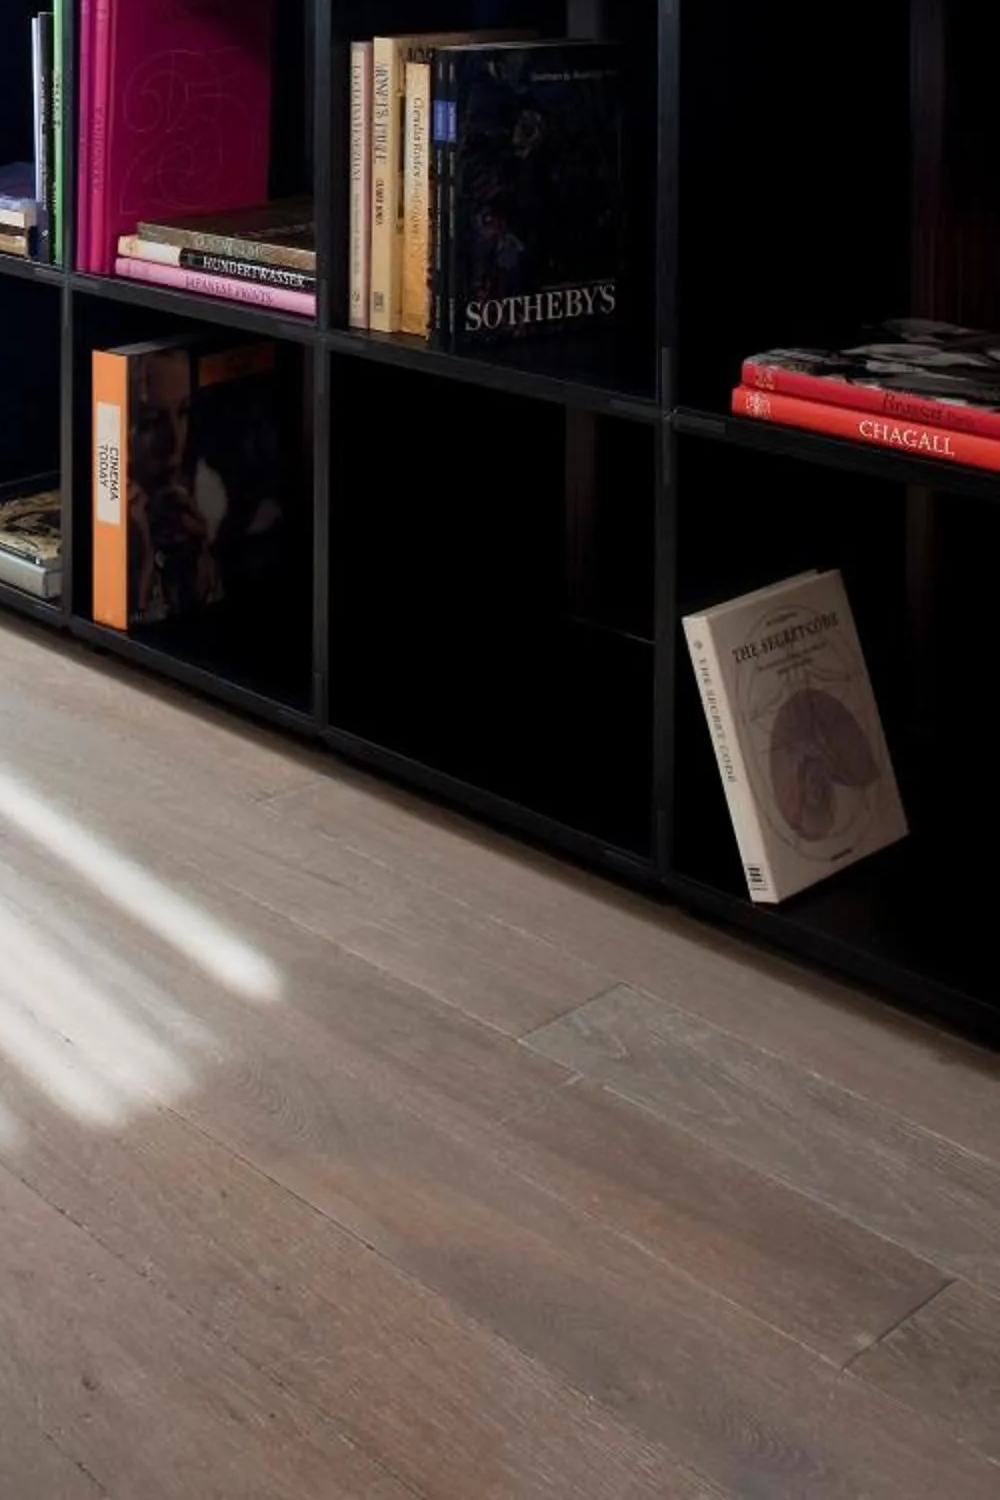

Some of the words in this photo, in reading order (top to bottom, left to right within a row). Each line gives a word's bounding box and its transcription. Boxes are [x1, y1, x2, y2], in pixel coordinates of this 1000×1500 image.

[465, 284, 617, 332] SOTHEBY'S
[857, 419, 956, 457] CHAGALL
[99, 443, 109, 488] TODAY
[109, 445, 120, 502] CINEMA
[731, 643, 759, 666] THE
[720, 745, 738, 784] CODE
